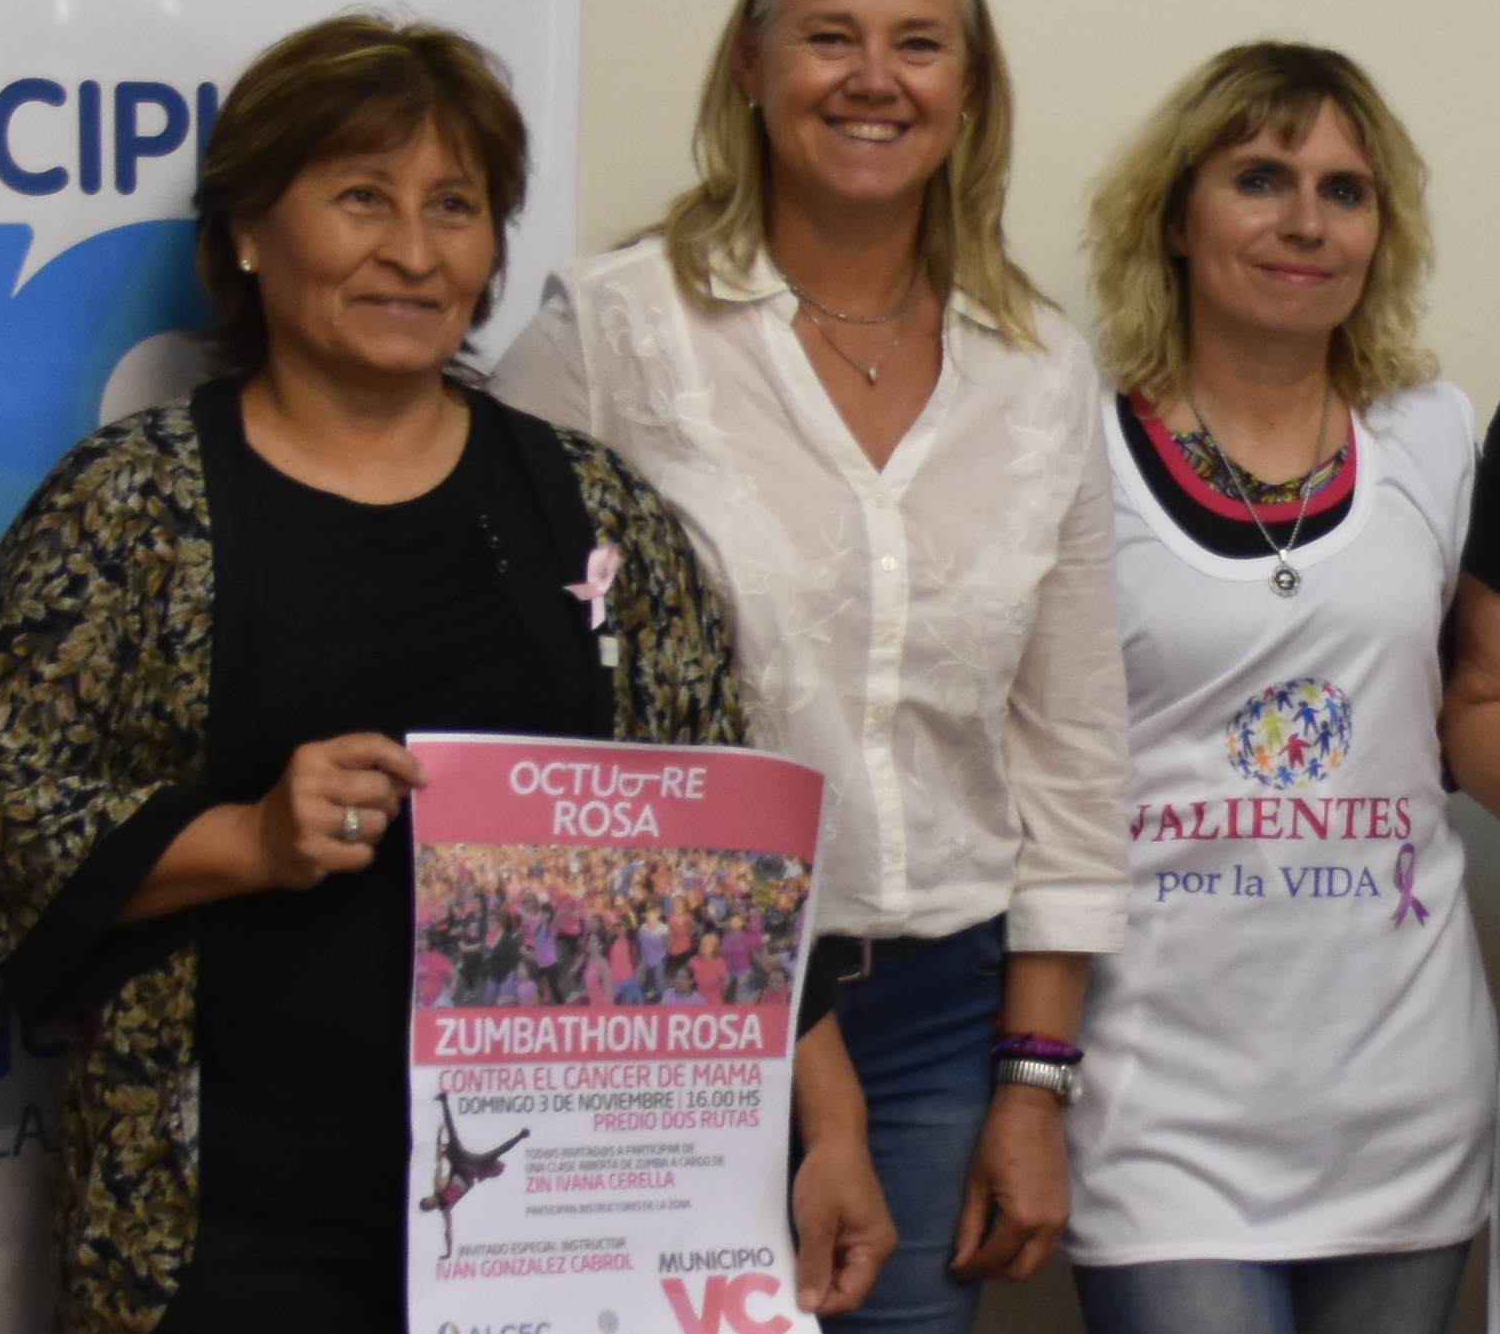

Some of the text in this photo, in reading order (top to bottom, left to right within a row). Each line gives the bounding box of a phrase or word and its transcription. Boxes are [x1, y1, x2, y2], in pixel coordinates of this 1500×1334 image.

[553, 801, 660, 838] ROSA
[1156, 865, 1381, 903] por la VIDA
[435, 1014, 764, 1055] ZUMBATHON ROSA
[439, 1068, 526, 1094] CONTRA
[533, 1067, 556, 1091] EL
[658, 1065, 685, 1088] DE
[693, 1064, 762, 1087] MAMA
[458, 1095, 534, 1115] DOMINGO
[539, 1095, 548, 1113] 3
[553, 1094, 573, 1112] DE
[579, 1092, 674, 1112] NOVIEMBRE
[739, 1090, 760, 1107] HS
[594, 1109, 759, 1131] PREDIO DOS RUTAS
[659, 1247, 775, 1274] MUNICIPIO
